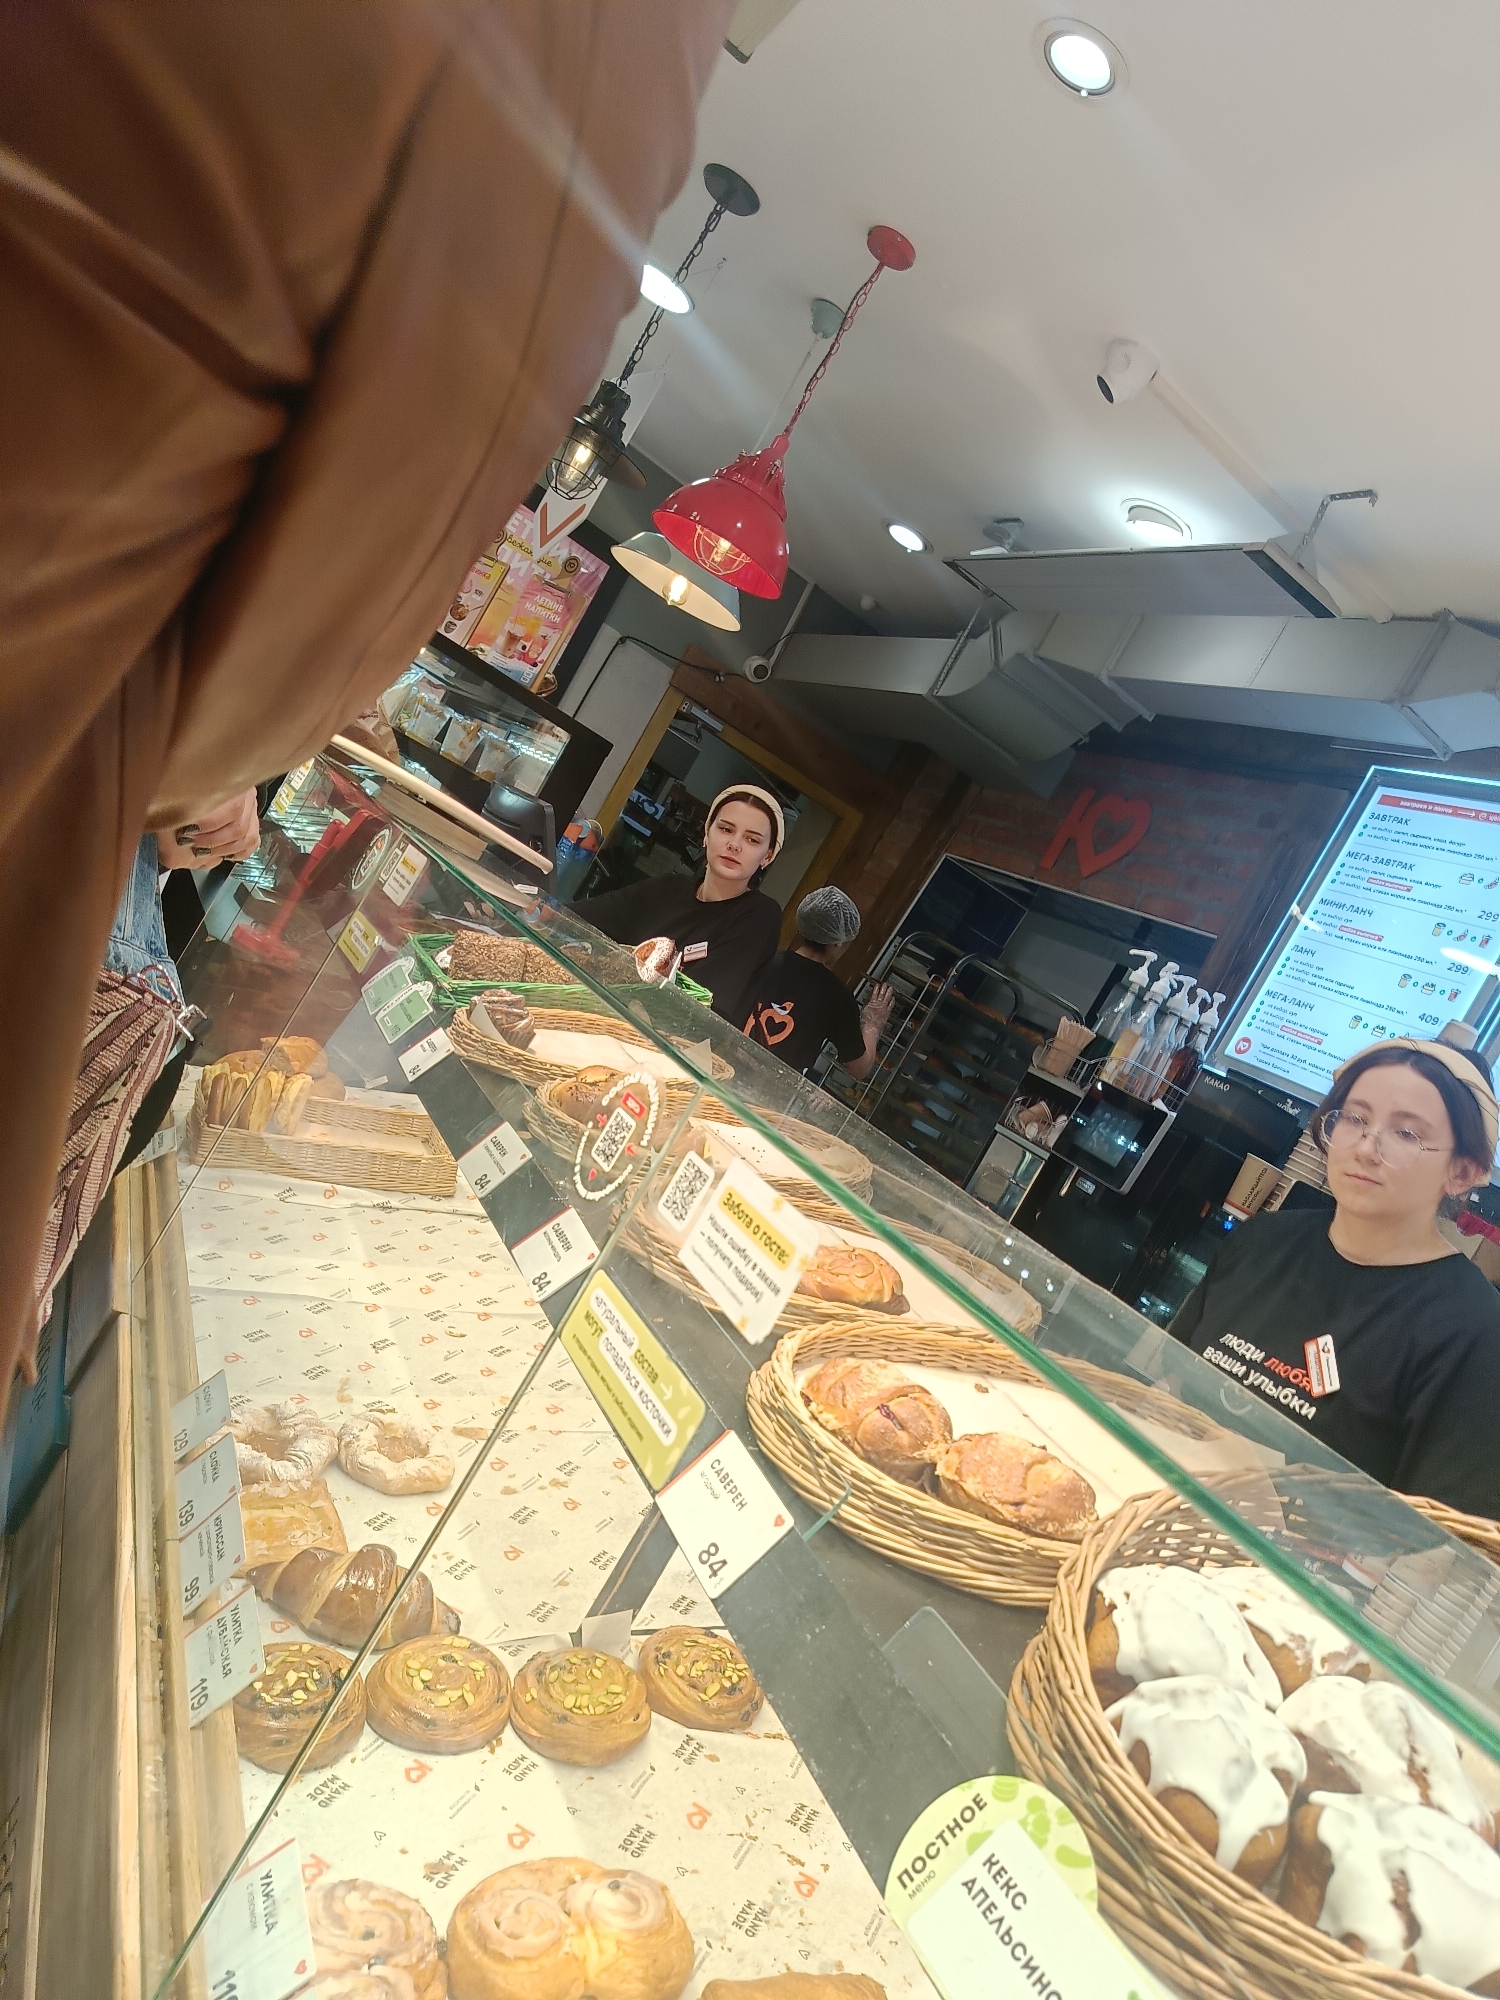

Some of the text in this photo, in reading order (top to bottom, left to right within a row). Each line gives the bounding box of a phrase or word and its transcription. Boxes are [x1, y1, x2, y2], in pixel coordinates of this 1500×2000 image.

[524, 601, 561, 625] НАПИТКИ
[533, 594, 564, 613] ЛЕТНИЕ
[1367, 811, 1411, 826] ЗАВТРАК
[1476, 910, 1500, 922] 299
[1289, 944, 1316, 957] ЛАНЧ
[1446, 962, 1470, 975] 299
[1417, 1012, 1440, 1026] 409
[1204, 1076, 1230, 1092] КАКАО
[490, 1136, 508, 1158] САВЕРЕН
[474, 1174, 492, 1191] 84
[706, 1213, 728, 1240] Нашли
[722, 1193, 752, 1229] Забота
[752, 1224, 760, 1236] о
[552, 1222, 572, 1252] САВЕРЕН
[532, 1272, 552, 1292] 84
[594, 1293, 659, 1384] натуральный состав
[1219, 1333, 1266, 1364] люди
[300, 1364, 325, 1377] MADE
[308, 1368, 332, 1381] HAND
[584, 1310, 672, 1438] могут попадаться косточки
[1202, 1346, 1247, 1378] ваши
[1243, 1370, 1317, 1420] улыбки
[174, 1428, 188, 1454] 129
[209, 1450, 220, 1484] СЛОЙКА
[700, 1470, 720, 1500] ягодный
[710, 1458, 748, 1512] САВЕРЕН
[178, 1499, 194, 1530] 139
[508, 1505, 532, 1522] MADE
[517, 1508, 540, 1526] HAND
[214, 1514, 226, 1562] КРУАССАН
[444, 1558, 469, 1577] MADE
[453, 1563, 478, 1581] HAND
[698, 1542, 728, 1579] 84
[184, 1576, 201, 1602] 99
[526, 1600, 550, 1620] MADE
[536, 1604, 560, 1624] HAND
[668, 1594, 690, 1613] MADE
[679, 1598, 698, 1616] HAND
[230, 1604, 242, 1646] УЛИТКА
[216, 1614, 232, 1679] ДУБАЙСКАЯ
[190, 1678, 208, 1711] 119
[502, 1754, 528, 1776] MADE
[513, 1760, 540, 1782] HAND
[306, 1774, 342, 1802] MADE
[318, 1780, 354, 1808] HAND
[784, 1802, 808, 1827] MADE
[799, 1809, 820, 1834] HAND
[618, 1824, 645, 1852] MADE
[631, 1830, 656, 1858] HAND
[896, 1793, 988, 1890] ПОСТНОЕ
[982, 1852, 1028, 1910] КЕКС
[260, 1868, 278, 1936] УЛИТКА
[732, 1900, 756, 1930] MADE
[744, 1906, 768, 1938] HAND
[212, 1970, 239, 2000] 11
